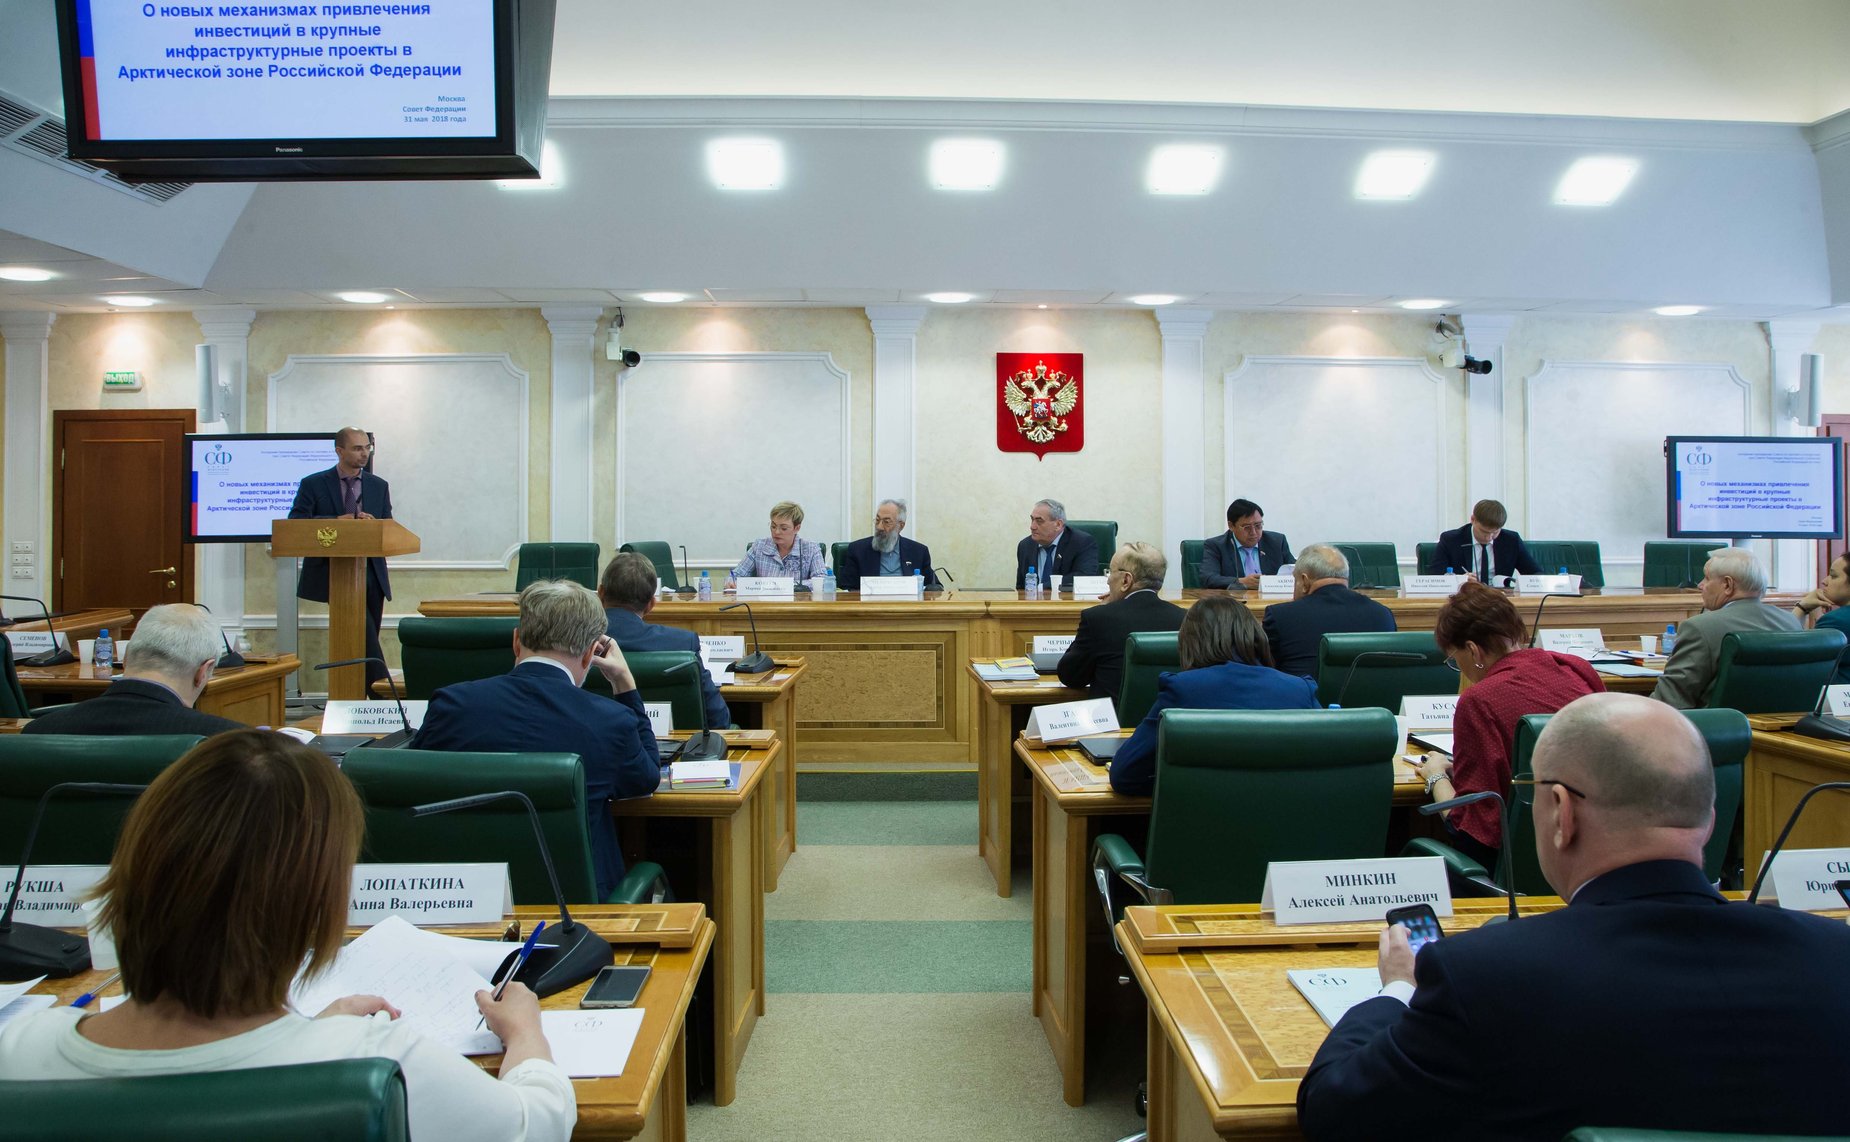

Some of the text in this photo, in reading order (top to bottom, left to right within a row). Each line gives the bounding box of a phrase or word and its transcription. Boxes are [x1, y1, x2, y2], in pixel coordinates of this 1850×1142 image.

[142, 3, 431, 19] О новых механизмах привлечения
[194, 24, 381, 40] инвестиций в крупные
[165, 45, 412, 61] инфраструктурные проекты в
[118, 63, 462, 82] Арктической зоне Российской Федерации
[424, 105, 467, 113] Федерации
[431, 115, 449, 123] 2018
[106, 373, 135, 384] ВЫХОД
[204, 451, 233, 465] СФ
[1686, 452, 1712, 466] СФ
[360, 877, 465, 891] ЛОПАТКИНА
[1325, 872, 1397, 888] МИНКИН
[348, 897, 474, 912] Анна Валерьевна
[1288, 891, 1439, 909] Алексей Анатольевич
